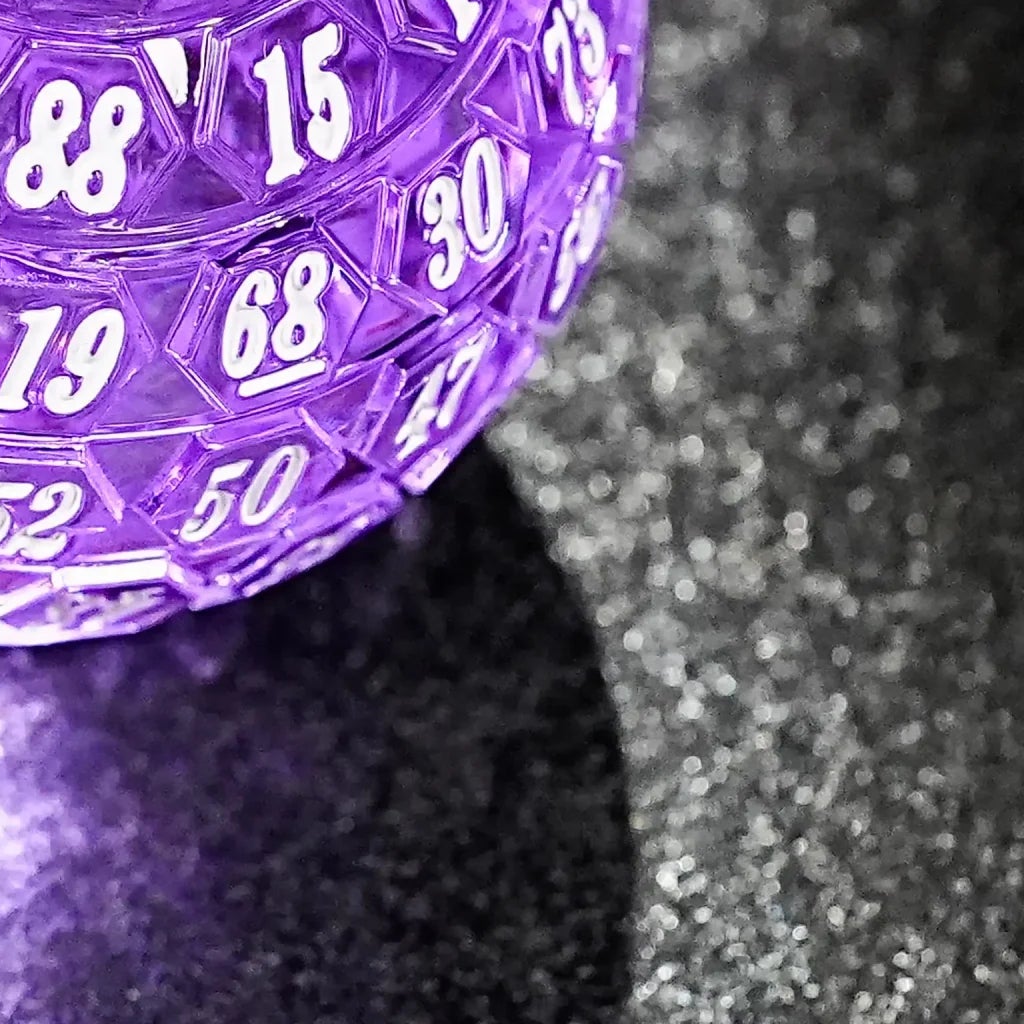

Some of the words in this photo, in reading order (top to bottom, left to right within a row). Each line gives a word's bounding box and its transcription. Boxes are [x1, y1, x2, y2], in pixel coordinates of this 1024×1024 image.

[6, 79, 143, 215] 88
[254, 22, 352, 185] 15
[423, 133, 509, 290] 30
[222, 251, 329, 379] 68
[180, 445, 310, 542] 50
